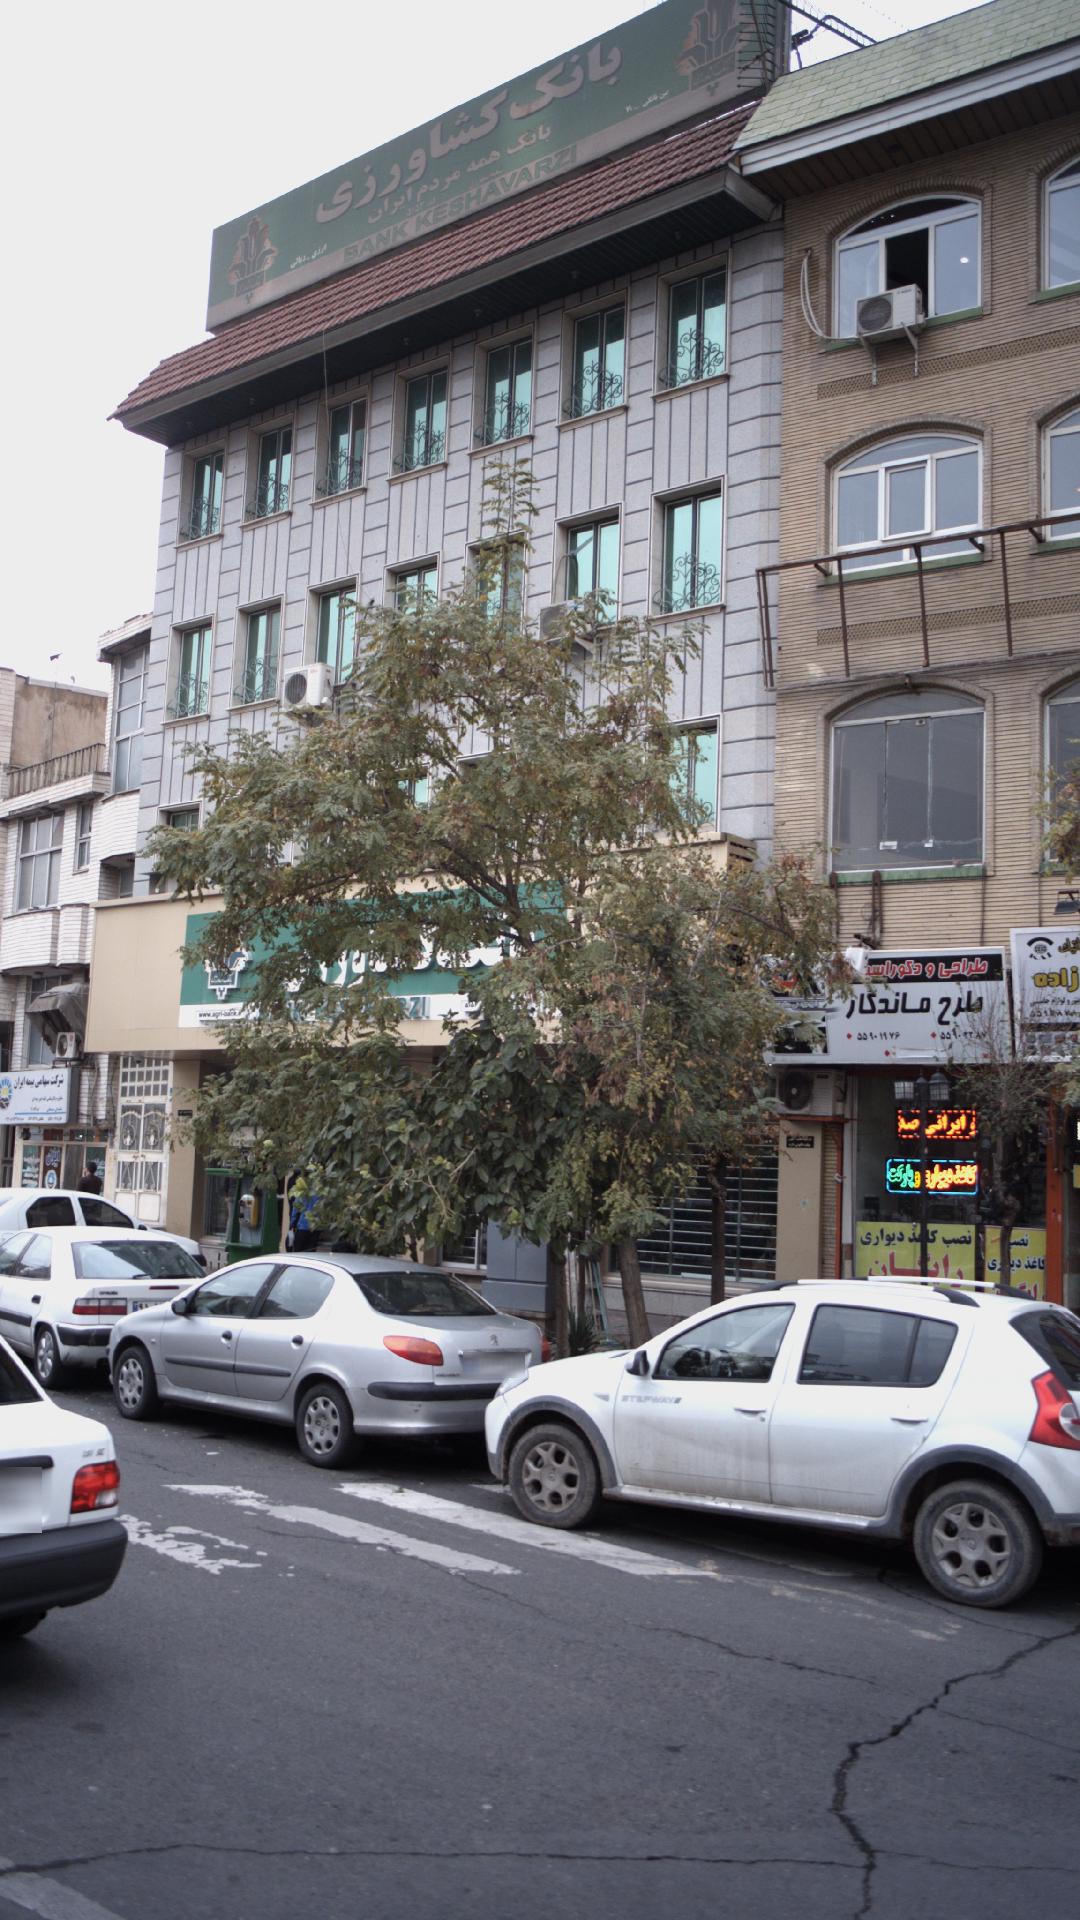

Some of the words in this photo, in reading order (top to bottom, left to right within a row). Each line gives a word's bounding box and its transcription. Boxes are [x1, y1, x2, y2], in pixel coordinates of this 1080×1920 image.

[510, 42, 621, 119] بانک
[507, 124, 551, 154] بانک
[316, 89, 508, 224] کشاورزی
[343, 224, 409, 262] BANK
[415, 144, 578, 233] KESHAVARZI
[925, 962, 936, 978] و
[938, 957, 988, 978] طراحی
[937, 990, 983, 1025] طرح
[925, 1113, 967, 1135] ایرانی
[860, 1227, 905, 1246] دیواری
[942, 1230, 972, 1248] نصب
